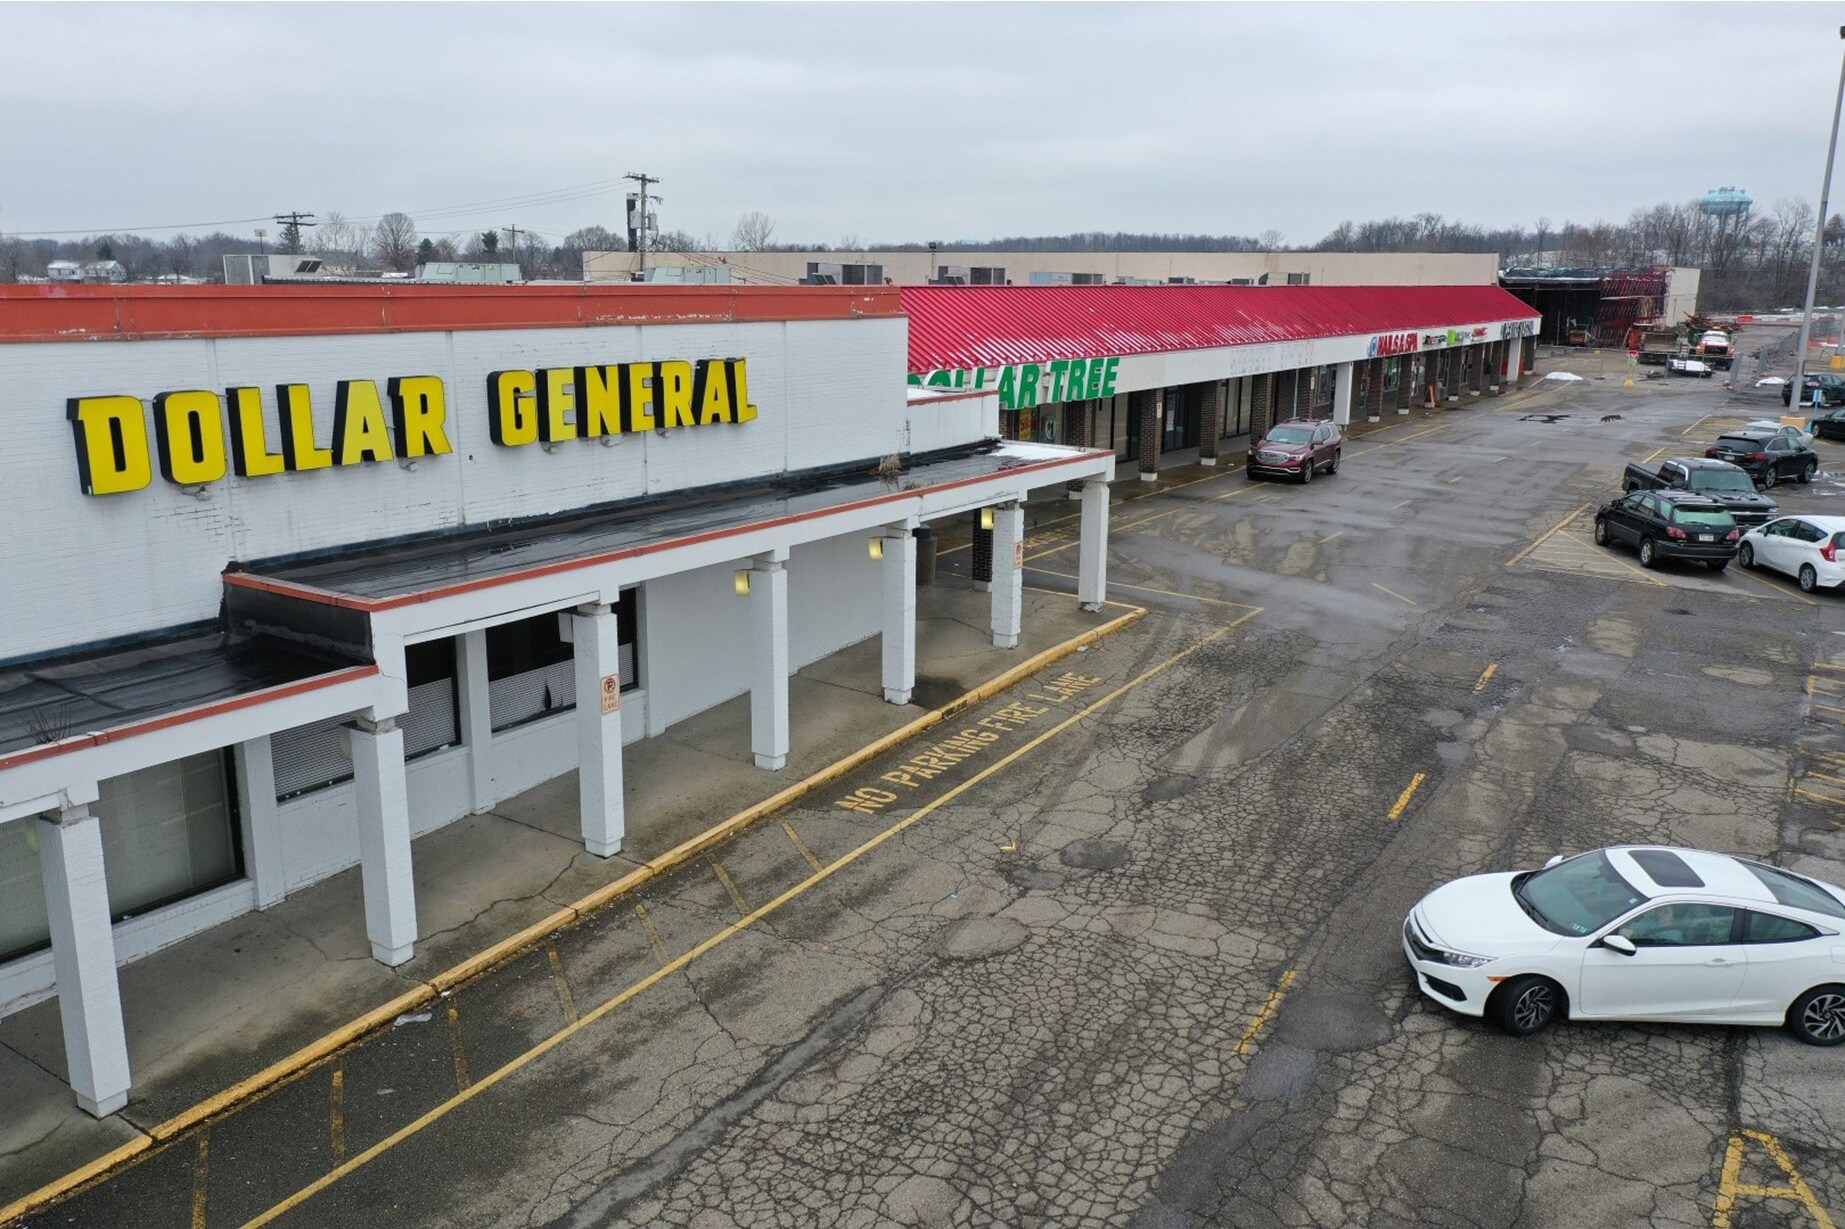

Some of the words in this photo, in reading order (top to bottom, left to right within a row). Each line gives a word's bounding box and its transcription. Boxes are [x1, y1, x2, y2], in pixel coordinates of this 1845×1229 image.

[66, 375, 453, 496] DOLLAR
[486, 356, 758, 447] GENERAL
[1050, 357, 1120, 404] TREE
[834, 786, 898, 814] NO
[880, 729, 1000, 788] PARKING
[977, 701, 1050, 731] FIRE
[1028, 671, 1102, 703] LANE
